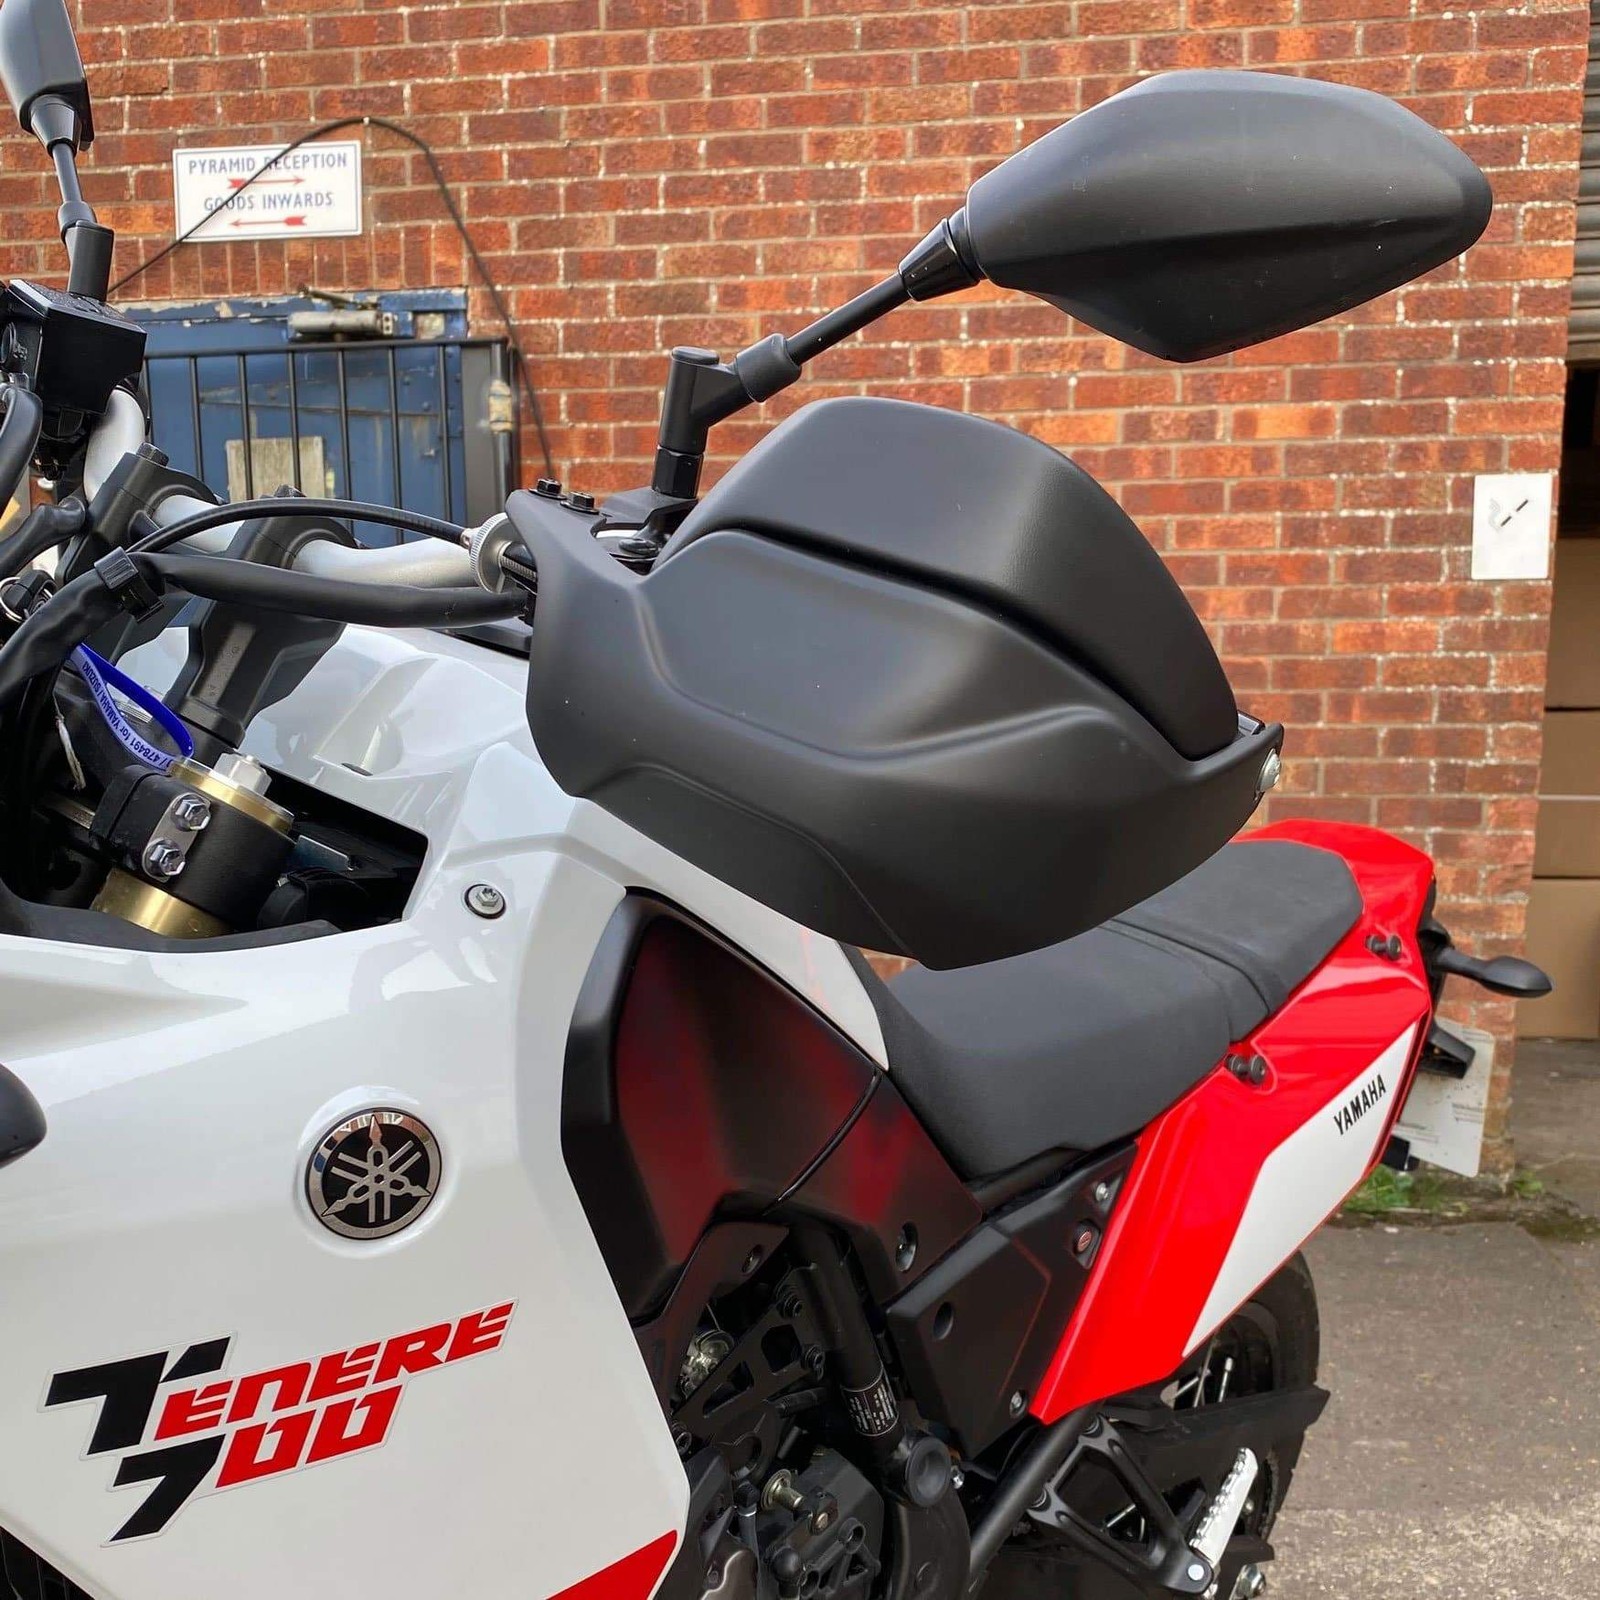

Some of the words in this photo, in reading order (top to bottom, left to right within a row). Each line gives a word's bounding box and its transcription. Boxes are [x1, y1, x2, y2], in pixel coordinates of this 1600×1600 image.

[188, 157, 256, 175] PYRAMID
[263, 152, 347, 170] RECEPTION
[203, 194, 255, 212] GOODS
[262, 191, 334, 209] INWARDS
[100, 692, 121, 730] YAMAHA
[119, 726, 131, 740] for
[130, 738, 161, 763] 478491
[1333, 1073, 1387, 1136] YAMAHA
[108, 1383, 403, 1543] 700
